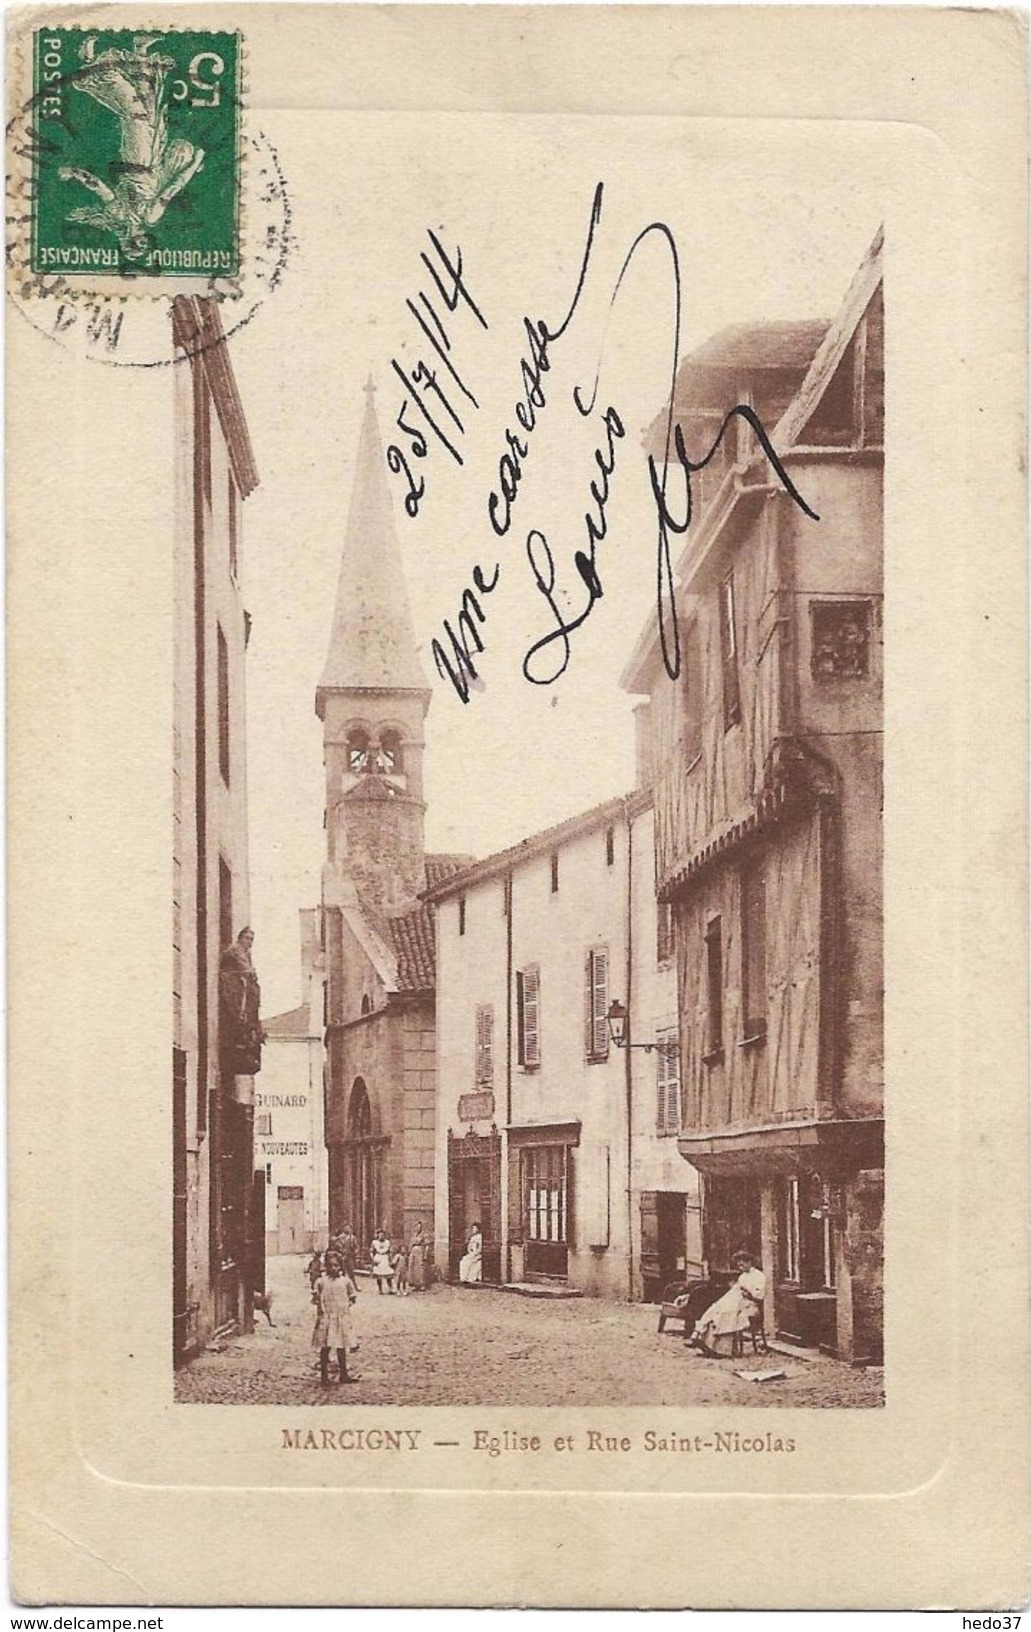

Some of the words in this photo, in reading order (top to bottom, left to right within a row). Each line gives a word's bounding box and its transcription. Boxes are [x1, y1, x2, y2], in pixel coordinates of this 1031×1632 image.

[43, 38, 62, 120] POSTES
[40, 247, 119, 267] FRANÇAISE
[281, 1429, 422, 1451] MARCIGNY
[472, 1430, 541, 1457] Eglise
[553, 1434, 575, 1452] et
[586, 1430, 632, 1452] Rue
[643, 1430, 796, 1453] Saint-Nicolas
